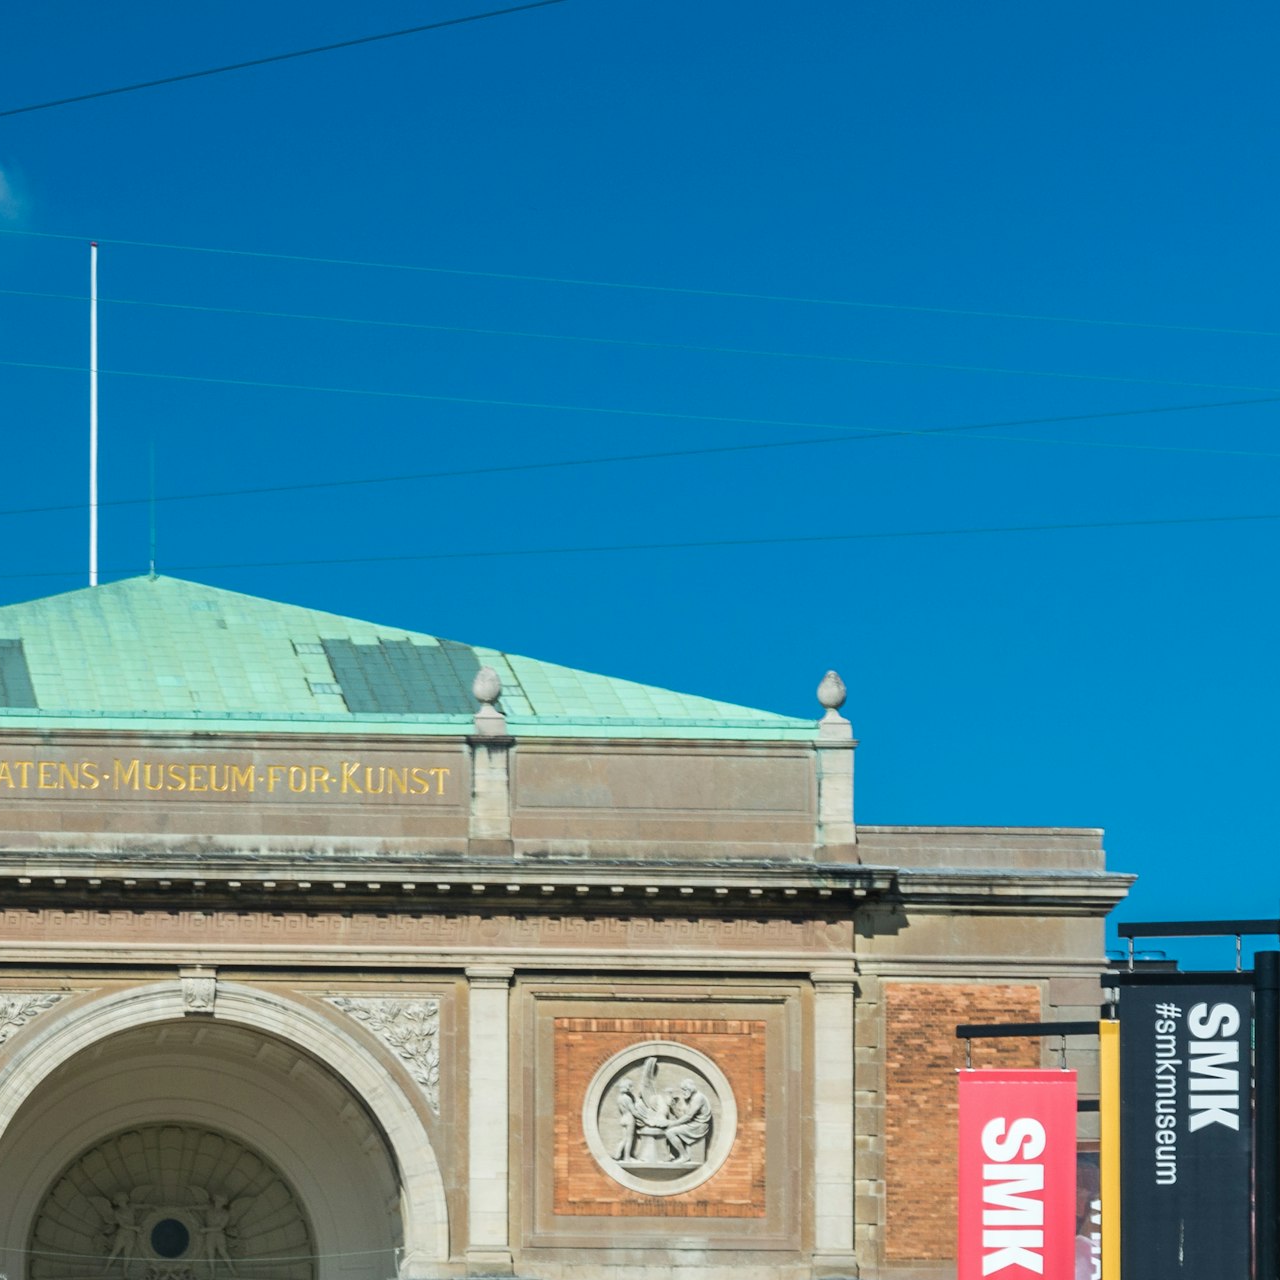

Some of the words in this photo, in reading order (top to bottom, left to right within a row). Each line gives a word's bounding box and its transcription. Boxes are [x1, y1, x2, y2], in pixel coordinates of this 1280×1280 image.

[1154, 1002, 1183, 1186] #smkmuseum
[1186, 1001, 1241, 1133] SMK
[980, 1116, 1047, 1278] SMK
